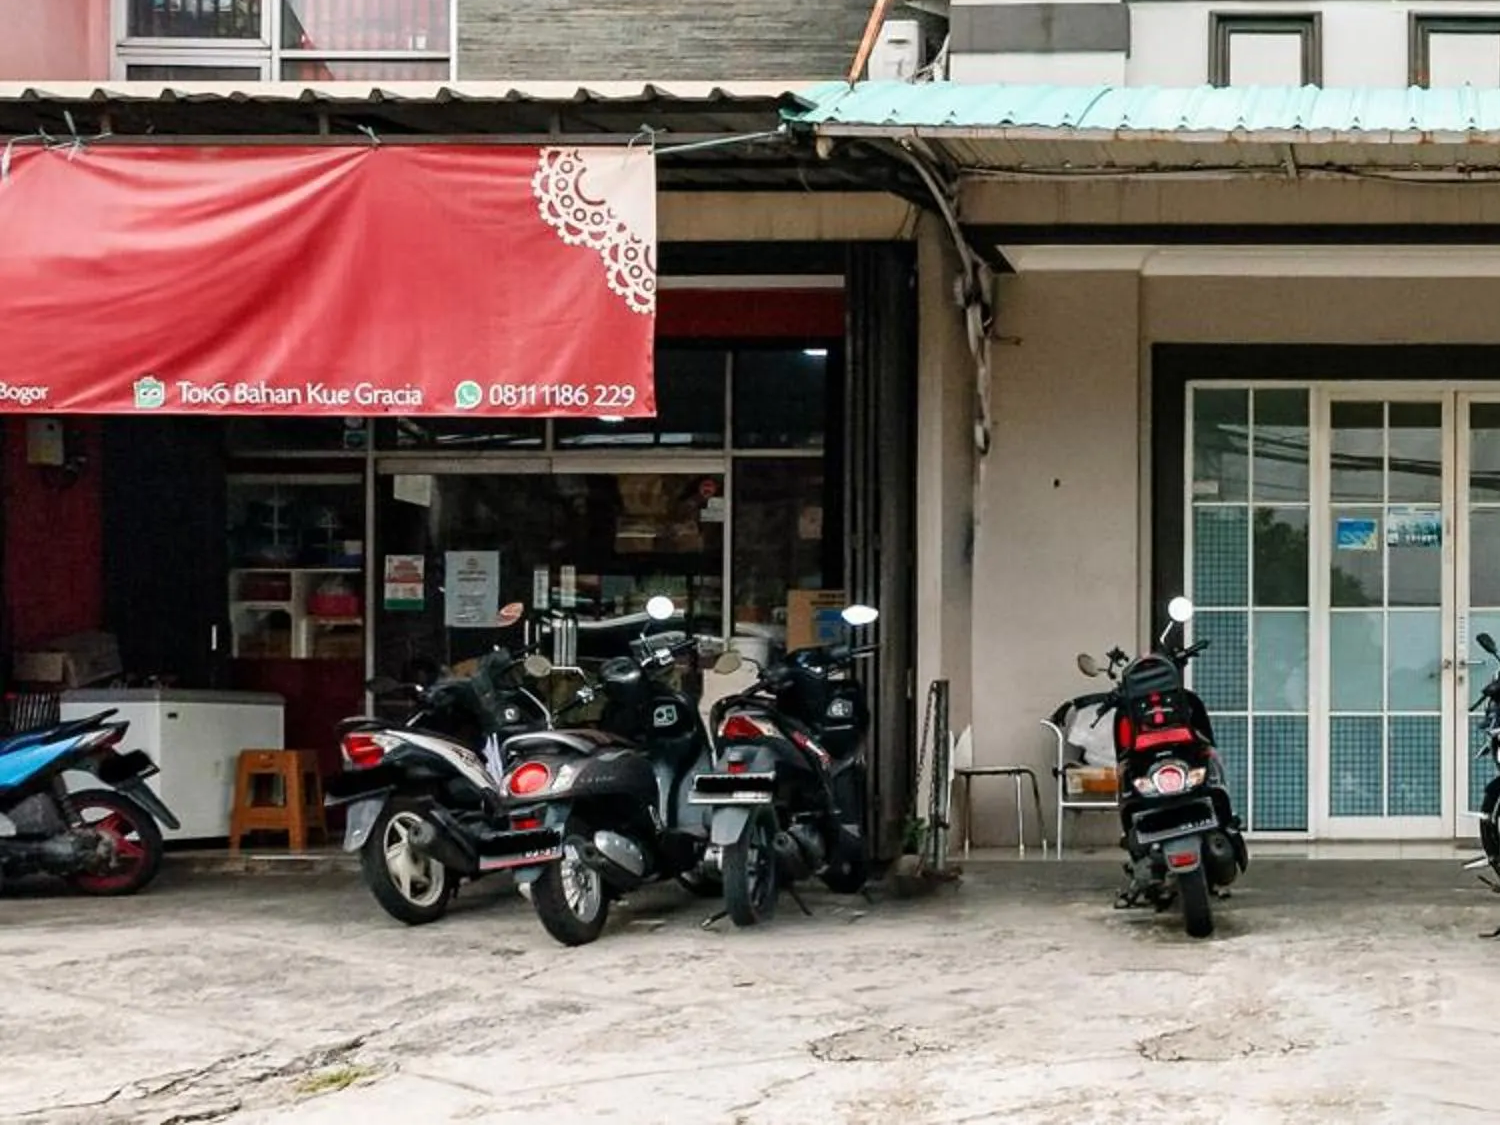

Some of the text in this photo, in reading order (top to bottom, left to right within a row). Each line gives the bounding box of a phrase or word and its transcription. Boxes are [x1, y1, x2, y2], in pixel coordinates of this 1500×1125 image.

[176, 381, 423, 406] Toko Bahan Kue Gracia
[488, 383, 636, 407] 0811 1186 229
